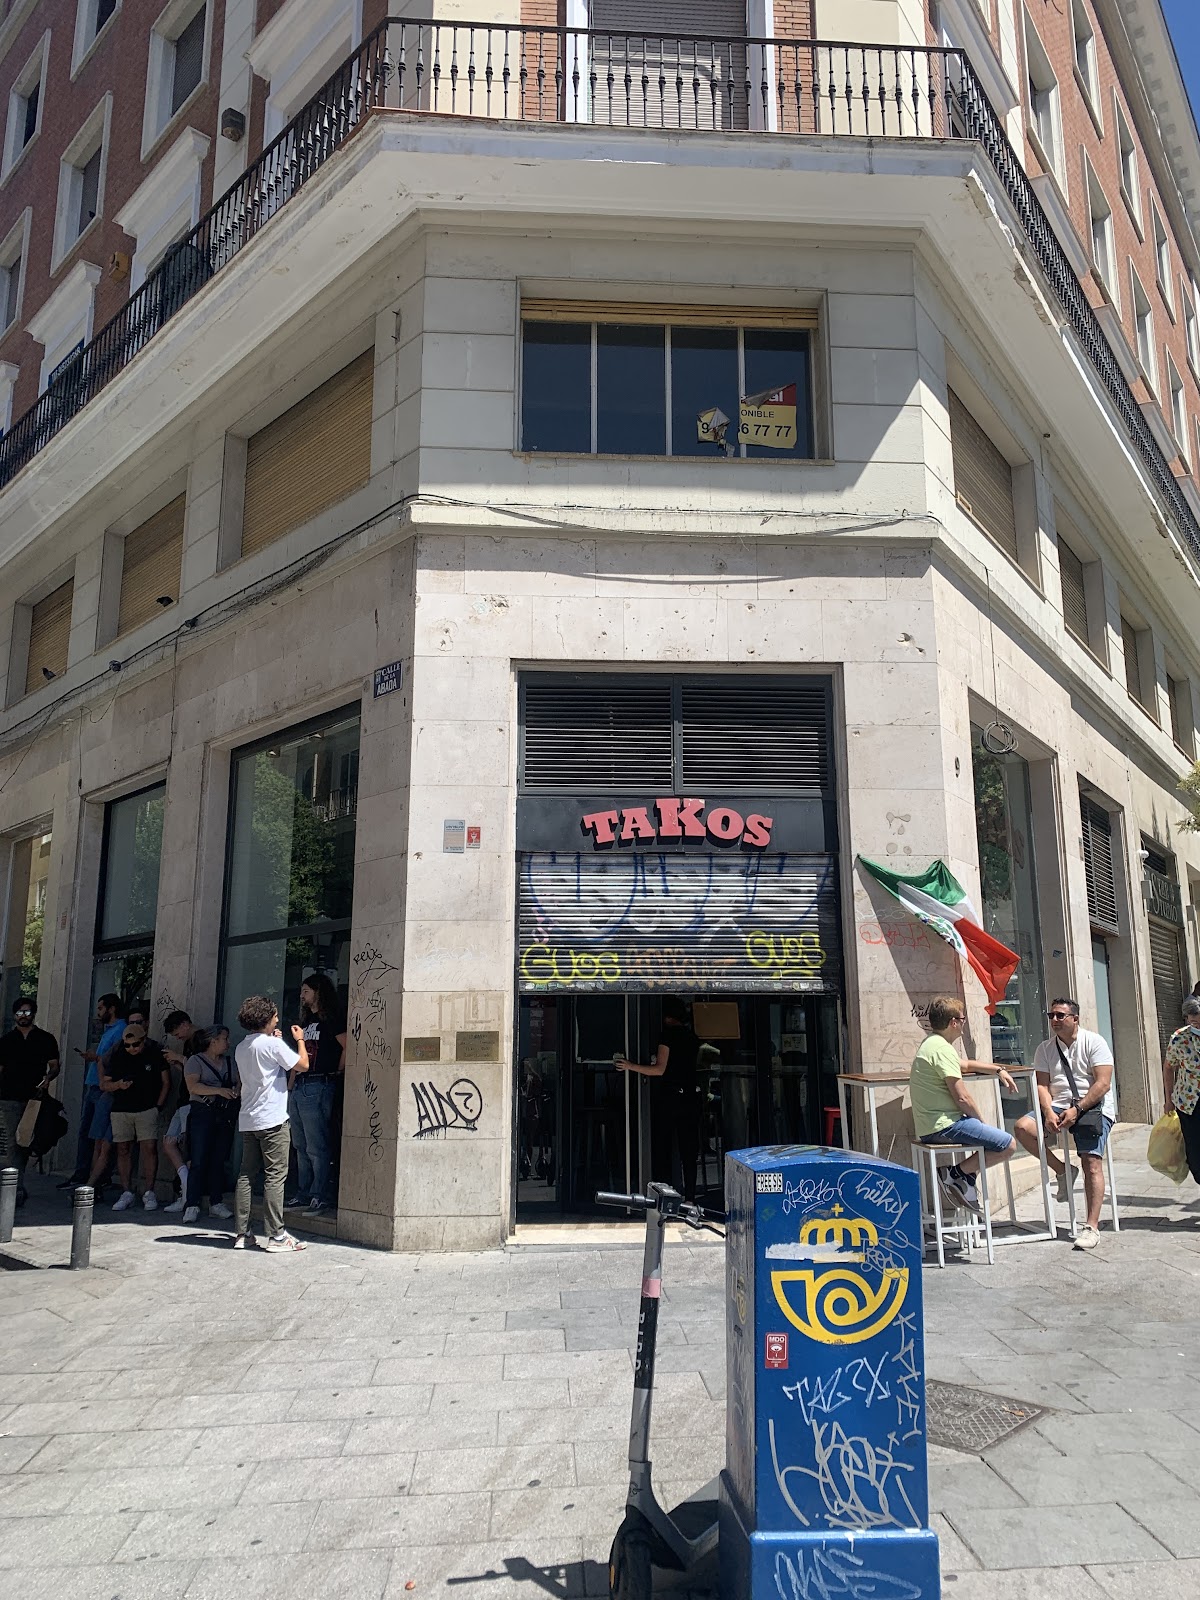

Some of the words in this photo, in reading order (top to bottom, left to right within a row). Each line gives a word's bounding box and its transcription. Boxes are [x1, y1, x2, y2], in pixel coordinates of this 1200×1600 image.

[741, 422, 749, 435] 6
[753, 424, 770, 437] 77
[774, 425, 792, 438] 77
[382, 663, 400, 676] CALLE
[377, 678, 397, 695] ABADA
[581, 797, 774, 850] TAKOS
[757, 1174, 771, 1186] FREE
